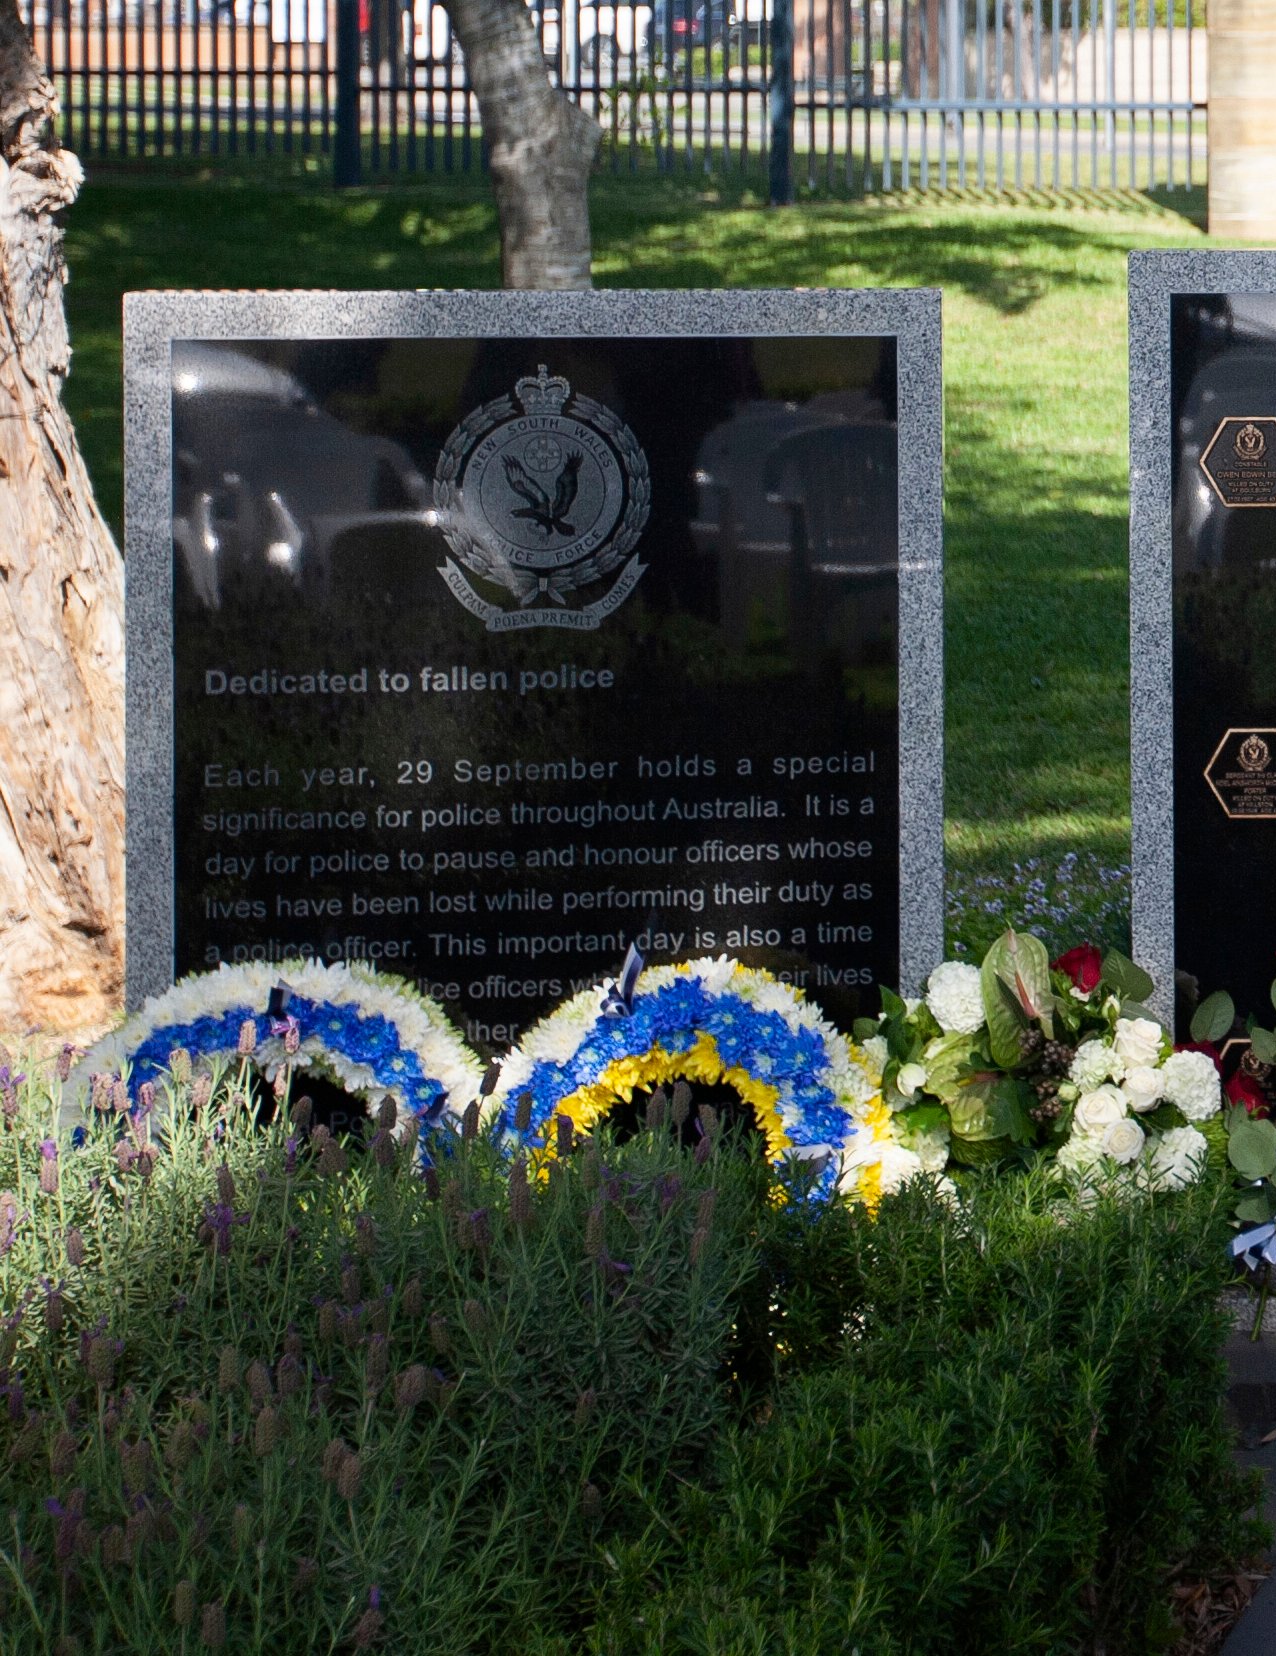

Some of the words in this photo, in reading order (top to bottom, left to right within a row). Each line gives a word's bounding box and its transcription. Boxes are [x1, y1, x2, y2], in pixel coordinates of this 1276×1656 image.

[472, 438, 498, 471] NEW
[507, 418, 559, 434] SOUTH
[574, 426, 613, 468] WALES
[556, 528, 602, 563] FORCE
[448, 572, 488, 615] CULPAM
[495, 614, 537, 629] POENA
[542, 613, 593, 628] PREMIT
[602, 571, 635, 611] COMES
[205, 668, 368, 695] Dedicated
[379, 669, 410, 693] to
[420, 666, 508, 692] fallen
[520, 664, 615, 695] police
[204, 763, 281, 788] Each
[302, 766, 376, 791] year,
[397, 760, 433, 784] 29
[454, 756, 619, 786] September
[639, 754, 717, 778] holds
[737, 759, 753, 775] a
[772, 750, 875, 780] special
[203, 807, 367, 837] significance
[375, 804, 413, 828] for
[421, 803, 501, 832] police
[511, 801, 655, 828] throughout
[662, 796, 787, 820] Australia.
[805, 794, 821, 816] It
[830, 794, 851, 815] is
[859, 797, 875, 815] a
[205, 851, 255, 879] day
[265, 851, 301, 873] for
[310, 850, 390, 878] police
[400, 850, 425, 870] to
[434, 853, 517, 874] pause
[526, 845, 575, 867] and
[584, 844, 678, 865] honour
[686, 840, 781, 863] officers
[788, 837, 873, 859] whose
[205, 895, 267, 919] lives
[276, 894, 343, 917] have
[353, 892, 420, 916] been
[429, 890, 477, 913] lost
[486, 888, 553, 911] while
[563, 885, 705, 914] performing
[713, 882, 772, 905] their
[779, 880, 835, 907] duty
[843, 882, 873, 900] as
[205, 946, 220, 963] a
[233, 939, 314, 960] police
[326, 936, 417, 959] officer.
[428, 933, 487, 956] This
[498, 929, 627, 959] important
[636, 929, 685, 955] day
[695, 926, 716, 949] is
[726, 925, 781, 948] also
[791, 927, 806, 944] a
[817, 922, 873, 944] time
[468, 975, 562, 999] officers
[816, 964, 873, 986] lives
